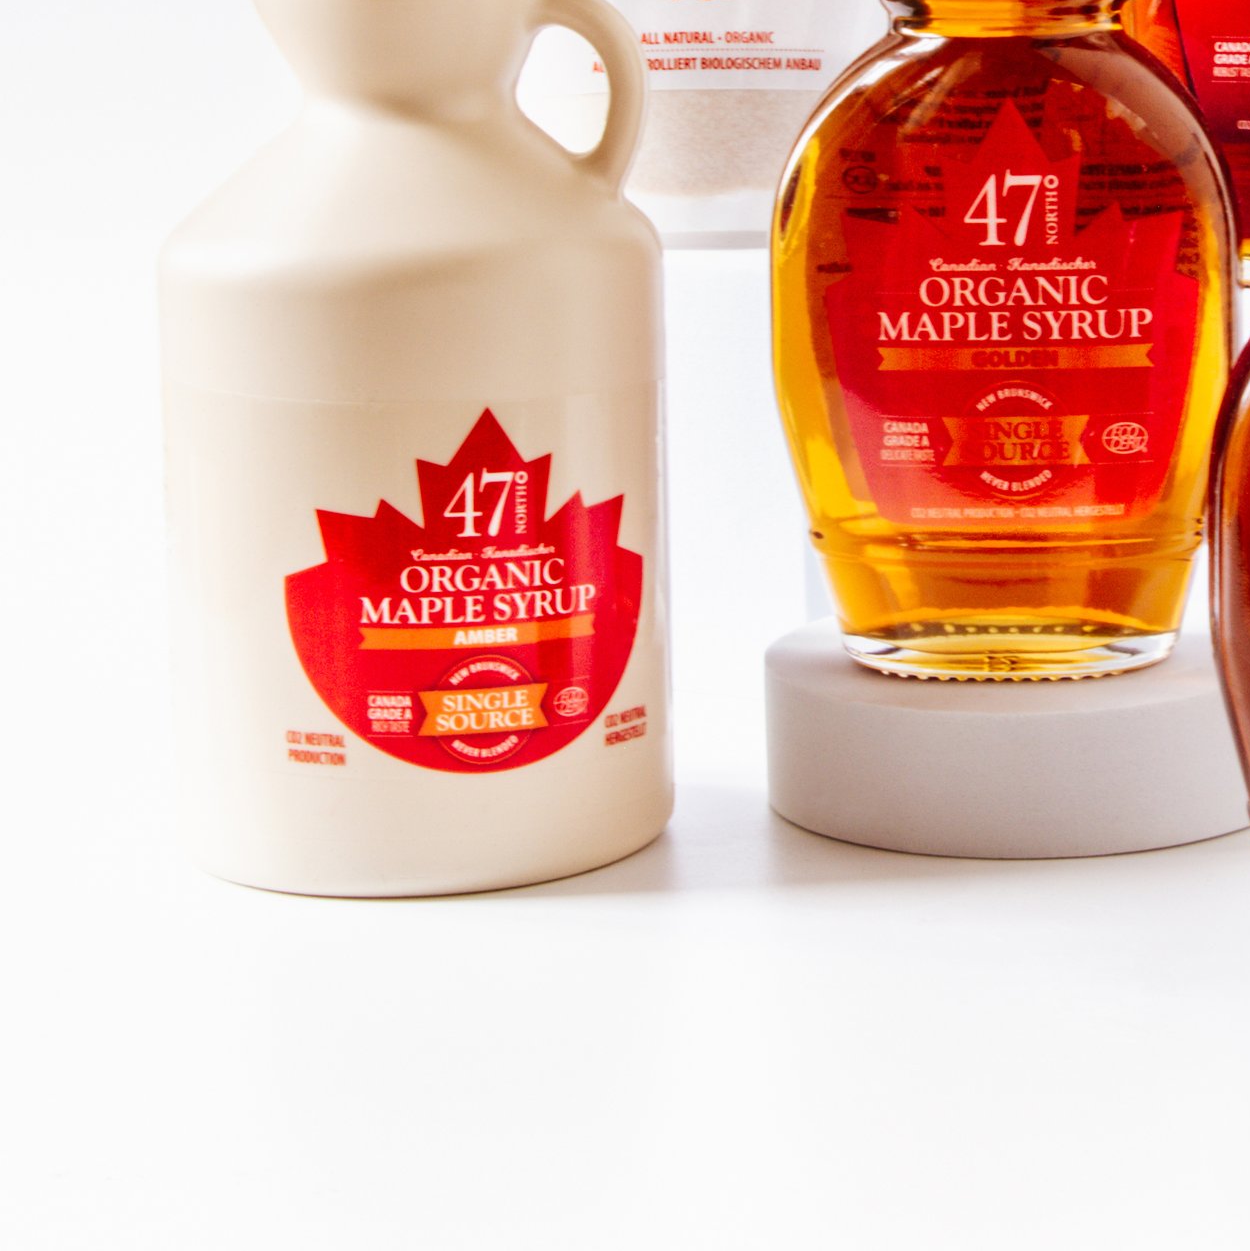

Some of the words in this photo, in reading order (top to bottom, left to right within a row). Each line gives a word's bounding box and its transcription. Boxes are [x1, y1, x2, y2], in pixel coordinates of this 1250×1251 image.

[641, 32, 660, 45] ALL
[663, 31, 714, 44] NATURAL
[724, 31, 775, 44] ORGANIC
[647, 58, 698, 70] ROLLIERT
[701, 58, 782, 70] BIOLOGISCHEM
[786, 58, 821, 70] ANBAU
[1046, 191, 1059, 245] NORTH
[929, 257, 996, 272] Canadian
[1007, 256, 1097, 271] Kanadischer
[919, 275, 1109, 307] ORGANIC
[877, 311, 1013, 342] MAPLE
[1022, 308, 1154, 341] SYRUP
[971, 350, 1058, 368] GOLDEN
[976, 391, 997, 412] NEW
[883, 422, 929, 434] CANADA
[883, 436, 920, 448] GRADE
[921, 436, 930, 448] A
[980, 471, 1009, 491] NEVER
[515, 485, 527, 534] NORTH
[400, 558, 564, 593] ORGANIC
[359, 595, 486, 624] MAPLE
[493, 584, 596, 621] SYRUP
[453, 628, 518, 646] AMBER
[367, 695, 412, 708] CANADA
[443, 690, 529, 713] SINGLE
[435, 708, 535, 733] SOURCE
